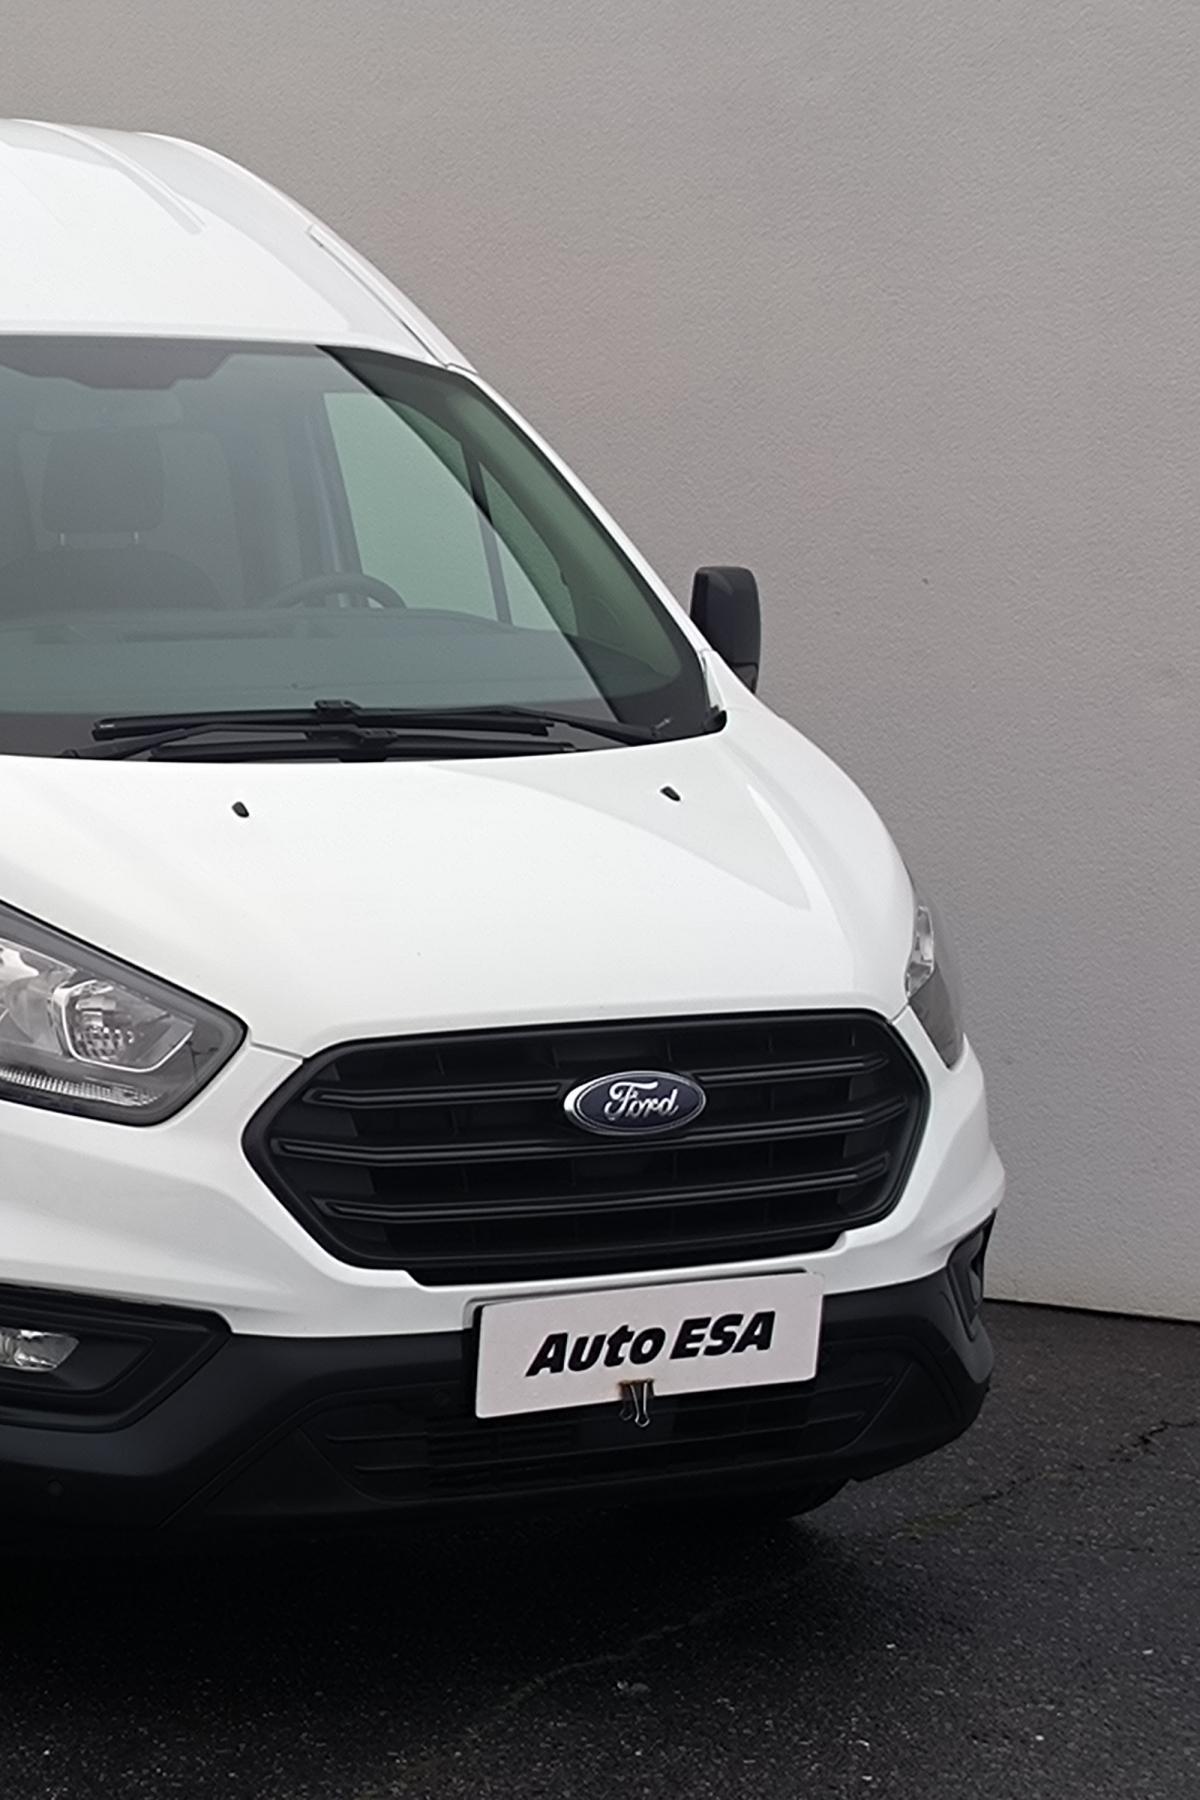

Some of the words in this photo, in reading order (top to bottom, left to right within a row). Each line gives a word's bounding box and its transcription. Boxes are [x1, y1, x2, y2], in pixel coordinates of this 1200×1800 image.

[603, 1081, 678, 1121] Ford
[525, 1324, 666, 1377] Auto
[669, 1310, 776, 1359] ESA
